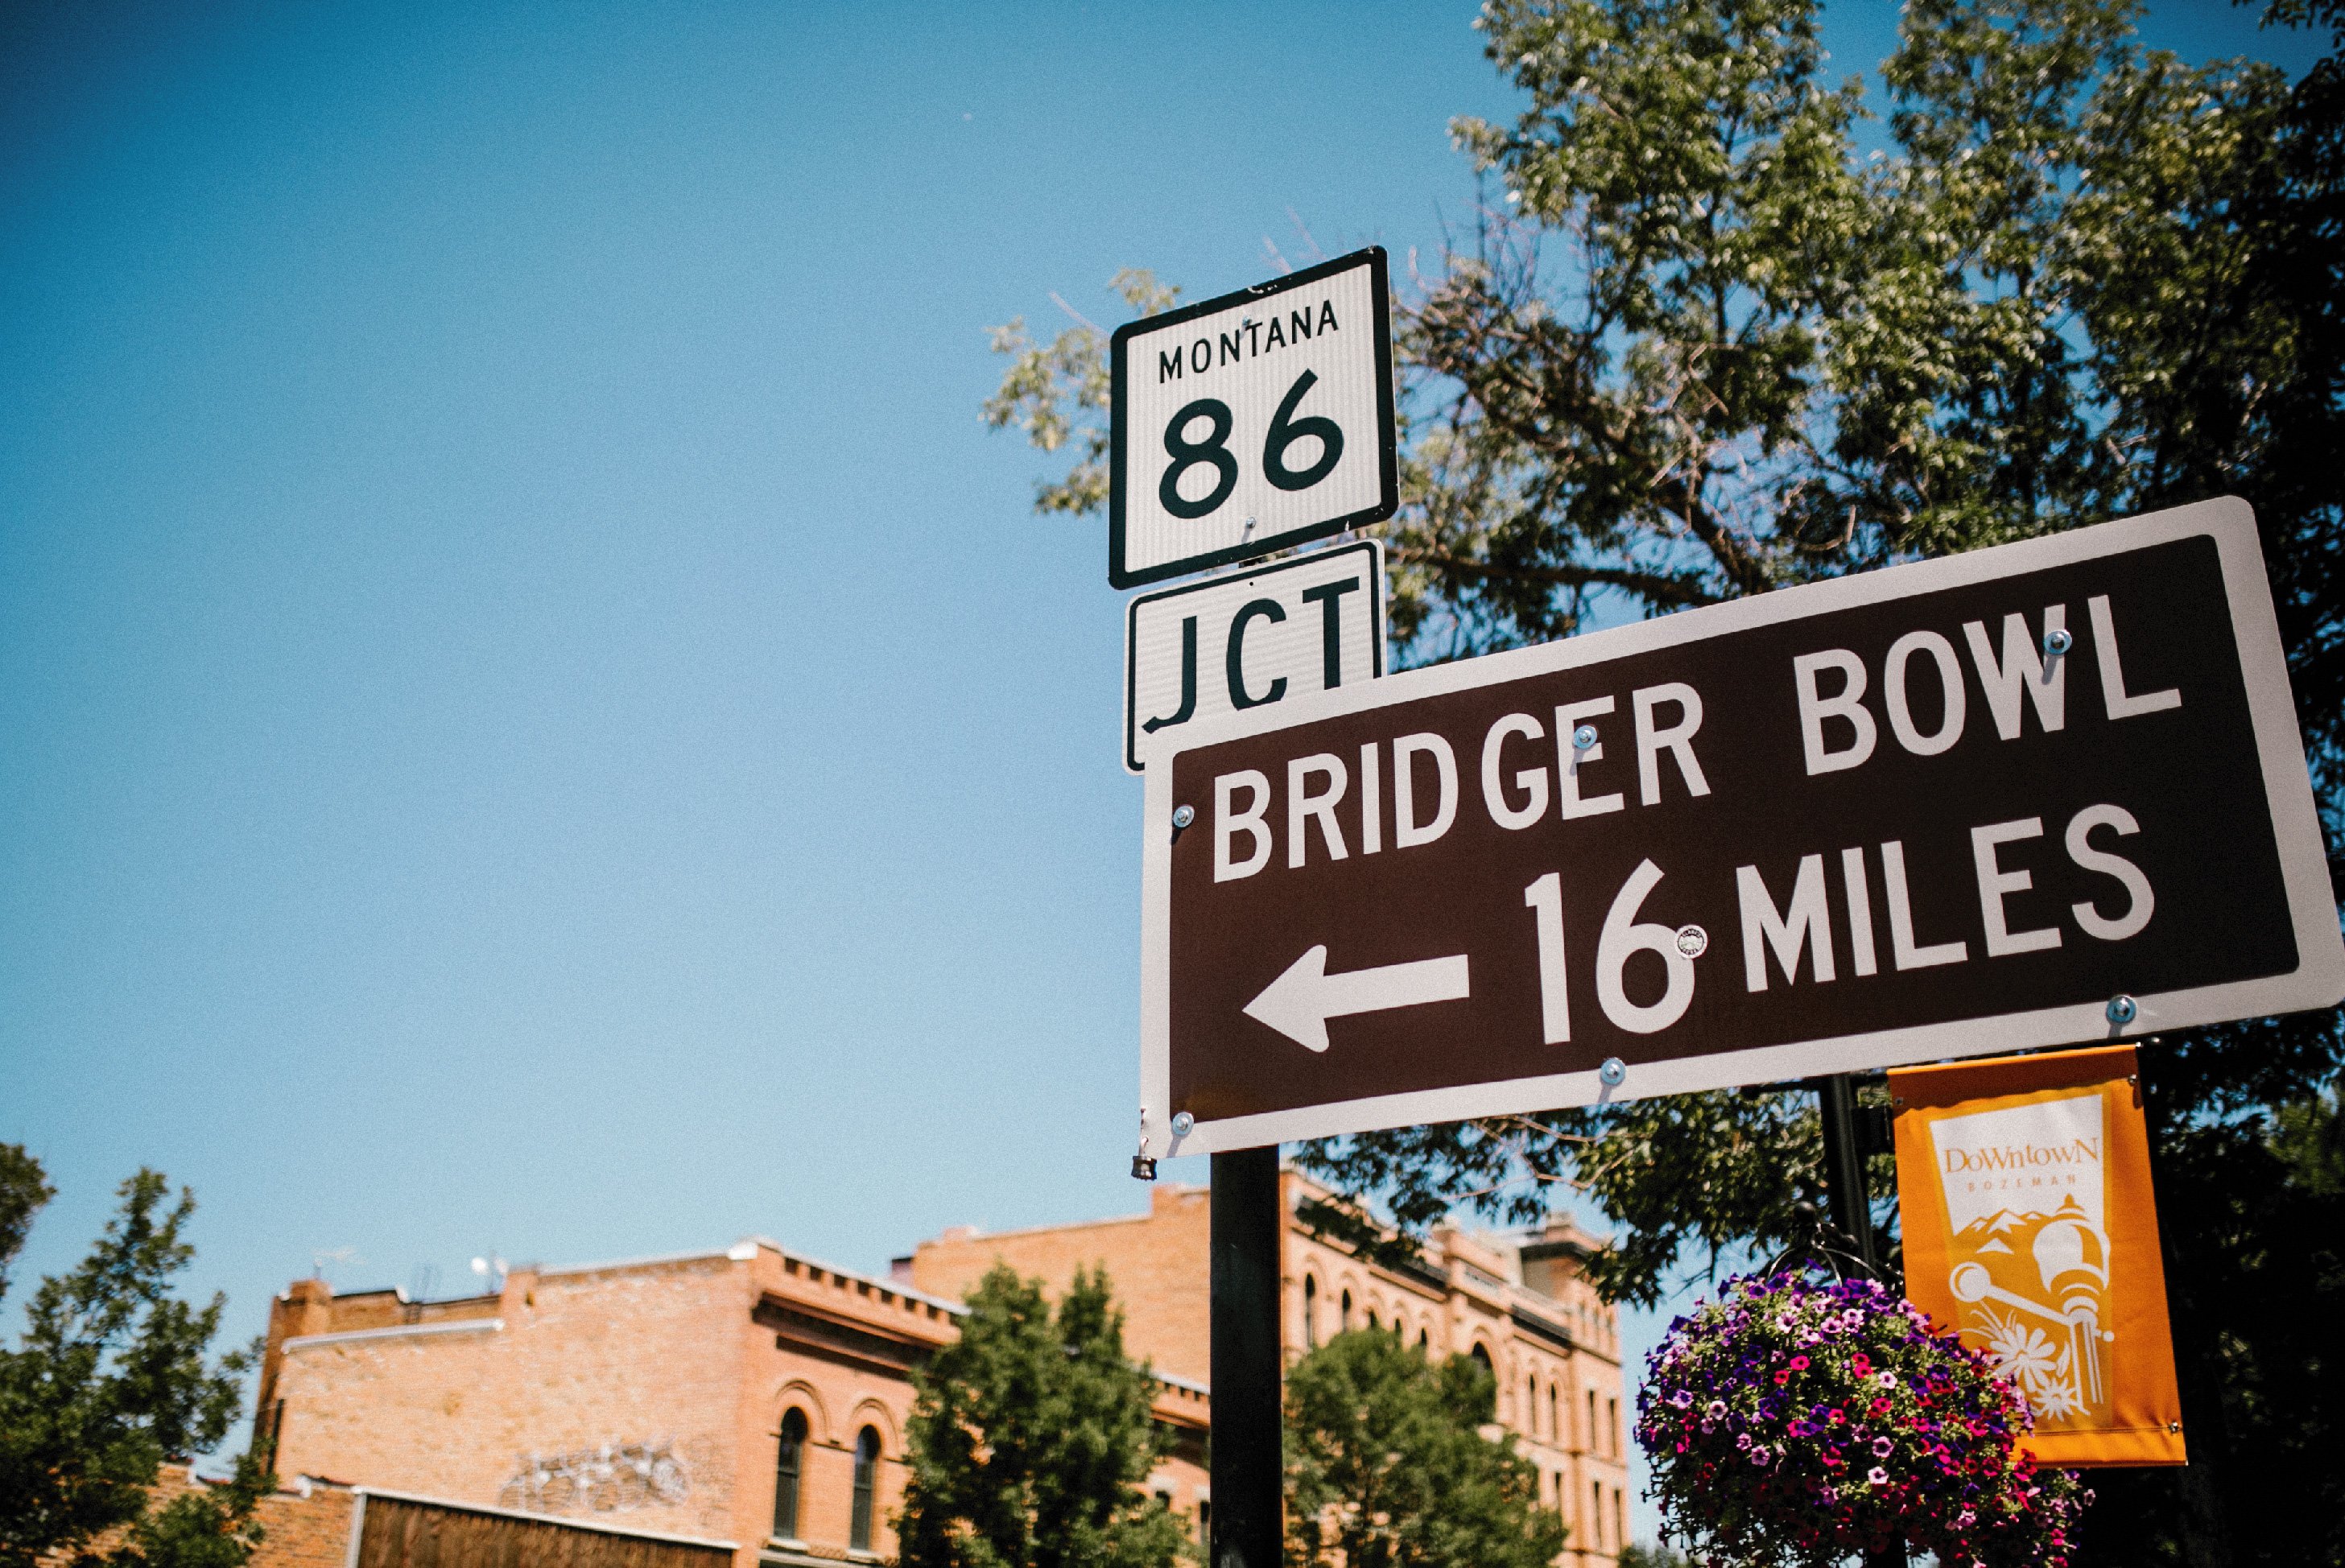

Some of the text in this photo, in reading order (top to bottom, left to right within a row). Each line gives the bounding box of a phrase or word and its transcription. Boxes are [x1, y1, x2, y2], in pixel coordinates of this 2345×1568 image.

[1159, 299, 1339, 383] MONTANA
[1159, 369, 1344, 519] 86
[1142, 576, 1359, 734] JCT
[1214, 595, 2182, 884] BRIDGER BOWL
[1525, 803, 2155, 1045] 16 MILES
[1967, 1175, 2076, 1192] BOZEMAN
